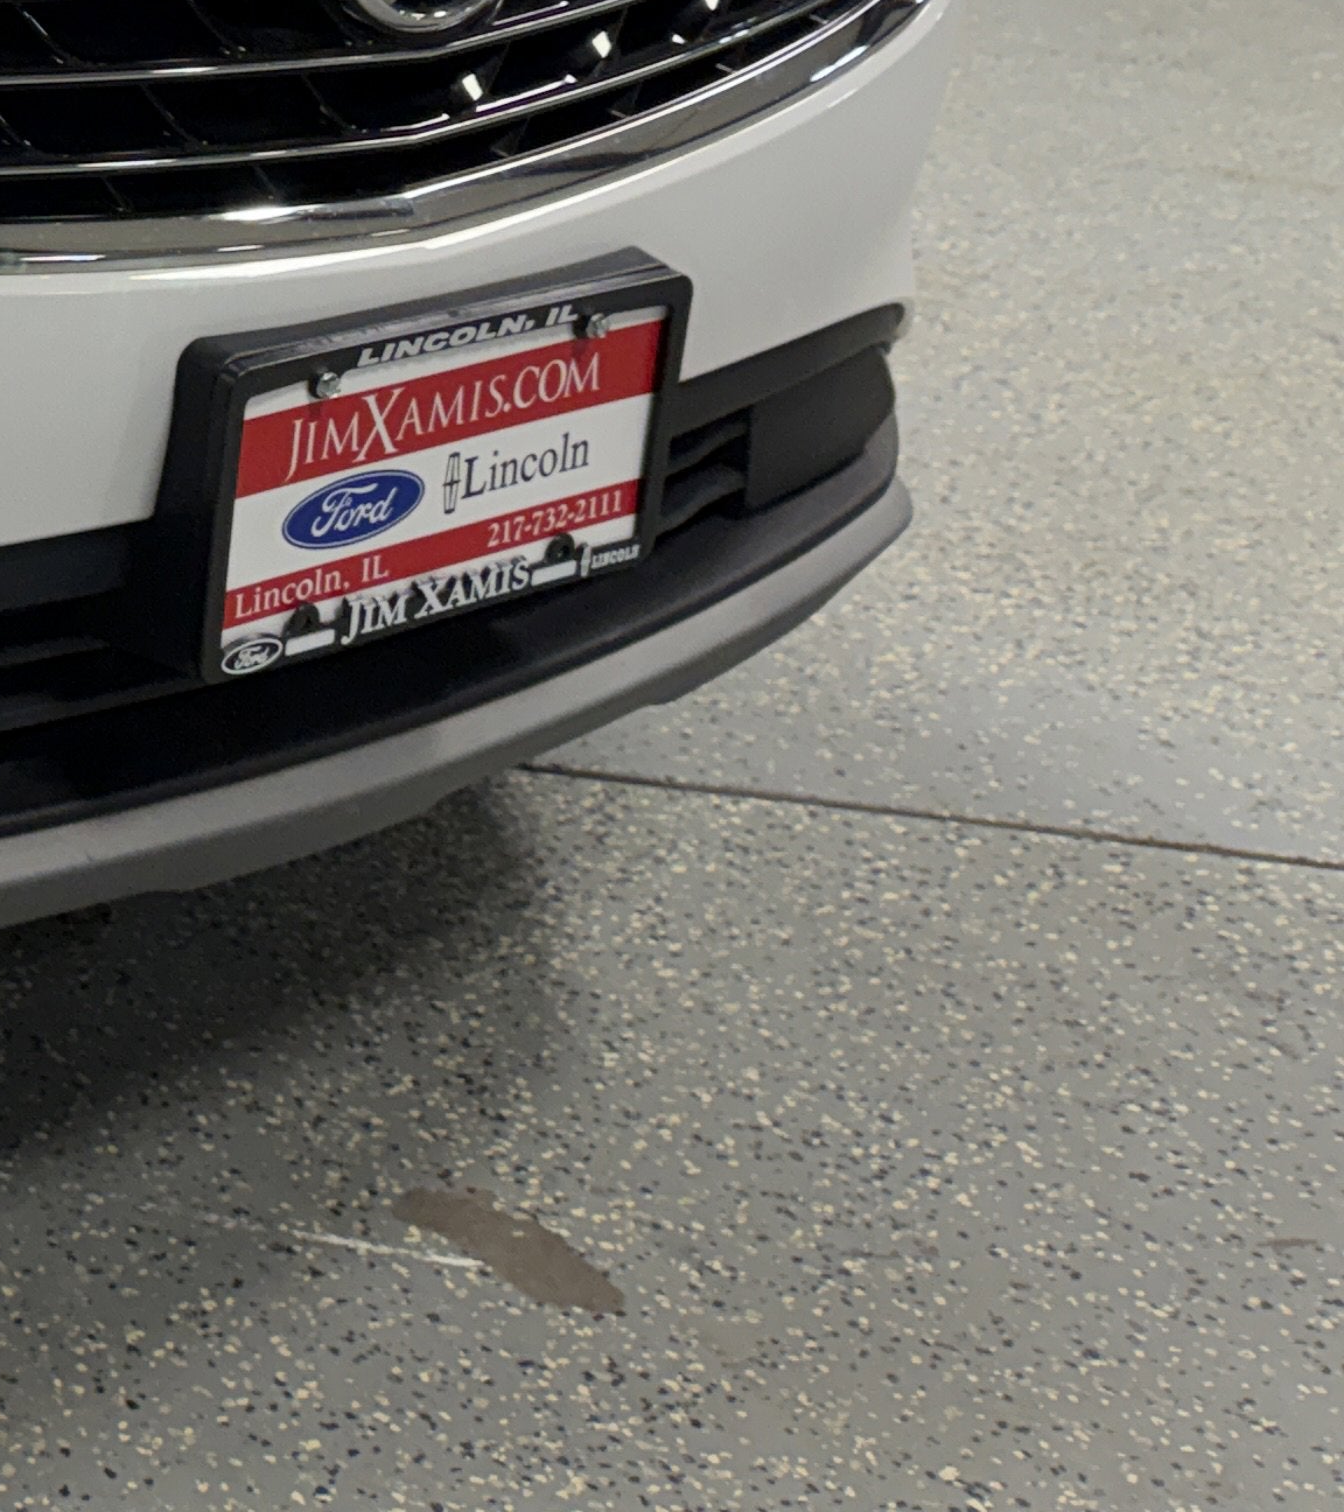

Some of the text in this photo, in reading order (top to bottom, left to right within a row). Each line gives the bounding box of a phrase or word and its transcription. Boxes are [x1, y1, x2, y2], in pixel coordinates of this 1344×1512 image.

[357, 304, 579, 368] LINCOLN, IL
[284, 352, 601, 482] JIMXAMIS.COM
[460, 432, 590, 500] Lincoln
[310, 482, 399, 538] Ford
[487, 489, 622, 548] 217-732-2111
[235, 555, 390, 619] Lincoln, IL
[590, 544, 641, 570] LINCOLN
[341, 560, 530, 645] JIM XAMIS
